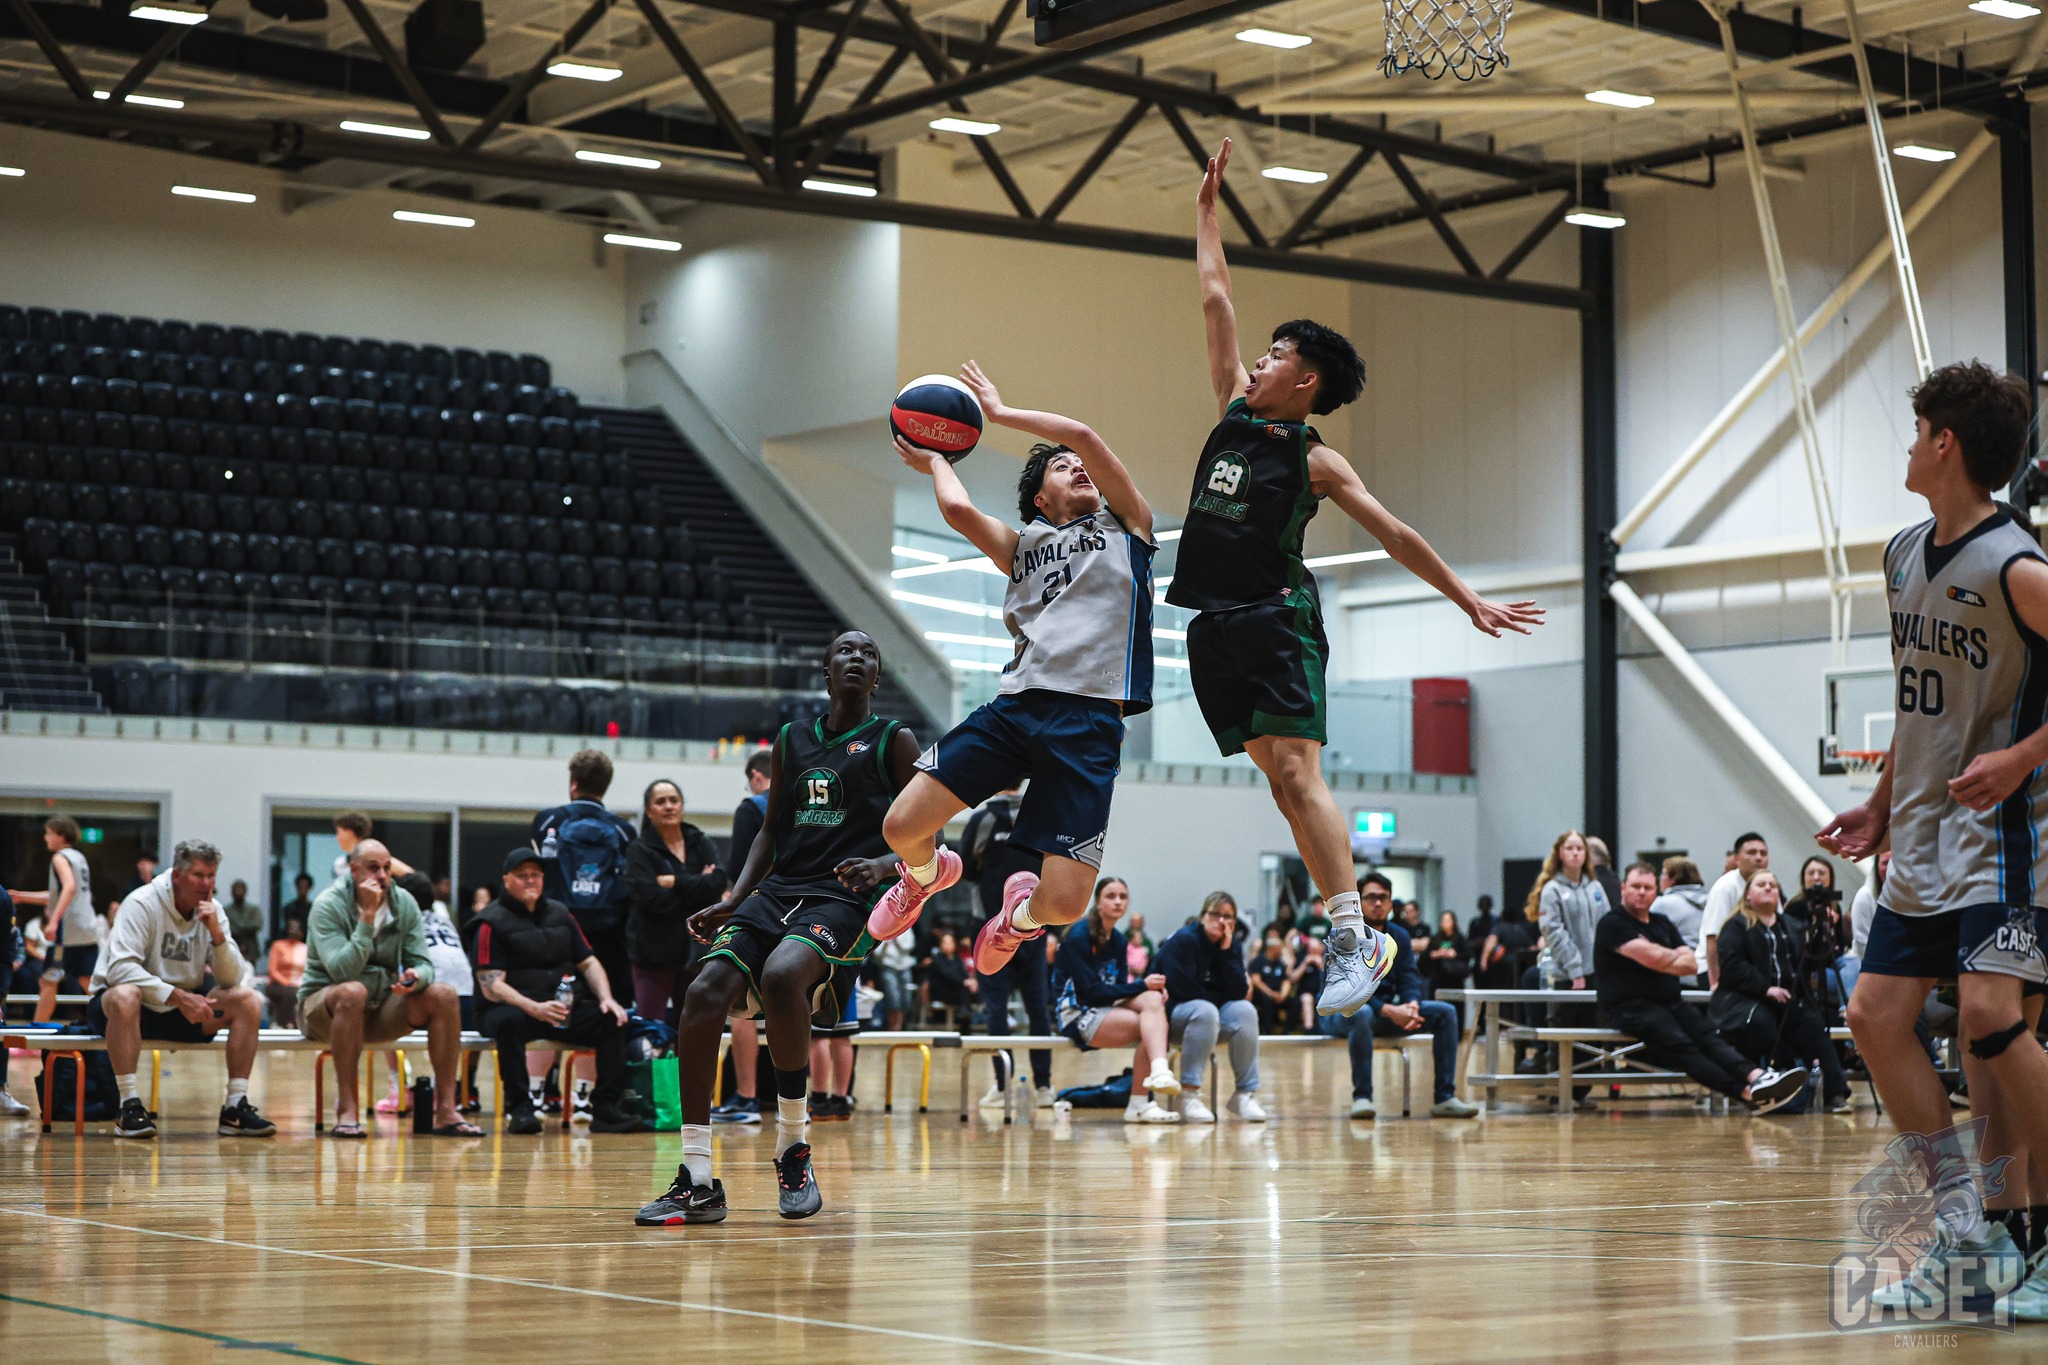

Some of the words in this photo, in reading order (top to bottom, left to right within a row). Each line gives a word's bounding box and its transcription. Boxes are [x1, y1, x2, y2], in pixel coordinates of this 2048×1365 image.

[906, 418, 969, 446] SPALDING
[1208, 460, 1243, 495] 29
[1194, 491, 1248, 520] RANGERS
[1011, 529, 1107, 584] CAVALERS
[1042, 563, 1073, 606] 21
[1899, 665, 1944, 716] 60
[807, 779, 829, 805] 15
[795, 810, 844, 825] RANGERS
